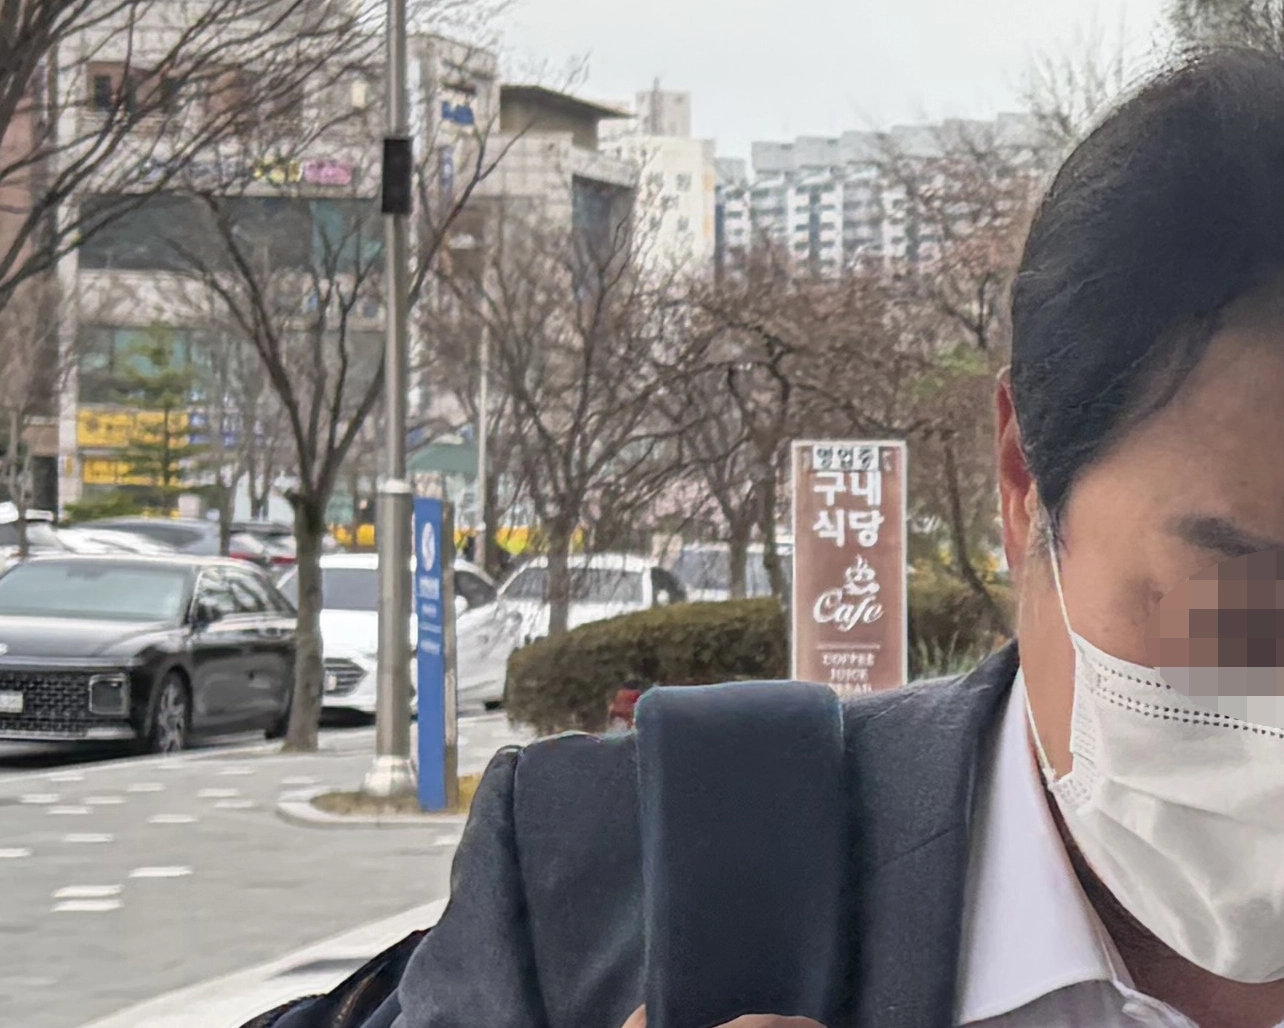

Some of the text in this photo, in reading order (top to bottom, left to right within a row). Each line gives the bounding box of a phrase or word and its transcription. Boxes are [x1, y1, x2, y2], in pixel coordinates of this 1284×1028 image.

[815, 447, 874, 470] 영업중
[813, 471, 882, 506] 구내
[813, 509, 884, 547] 식당
[813, 589, 884, 632] Cafe
[822, 652, 876, 667] COFFEE
[830, 668, 868, 681] JUICE
